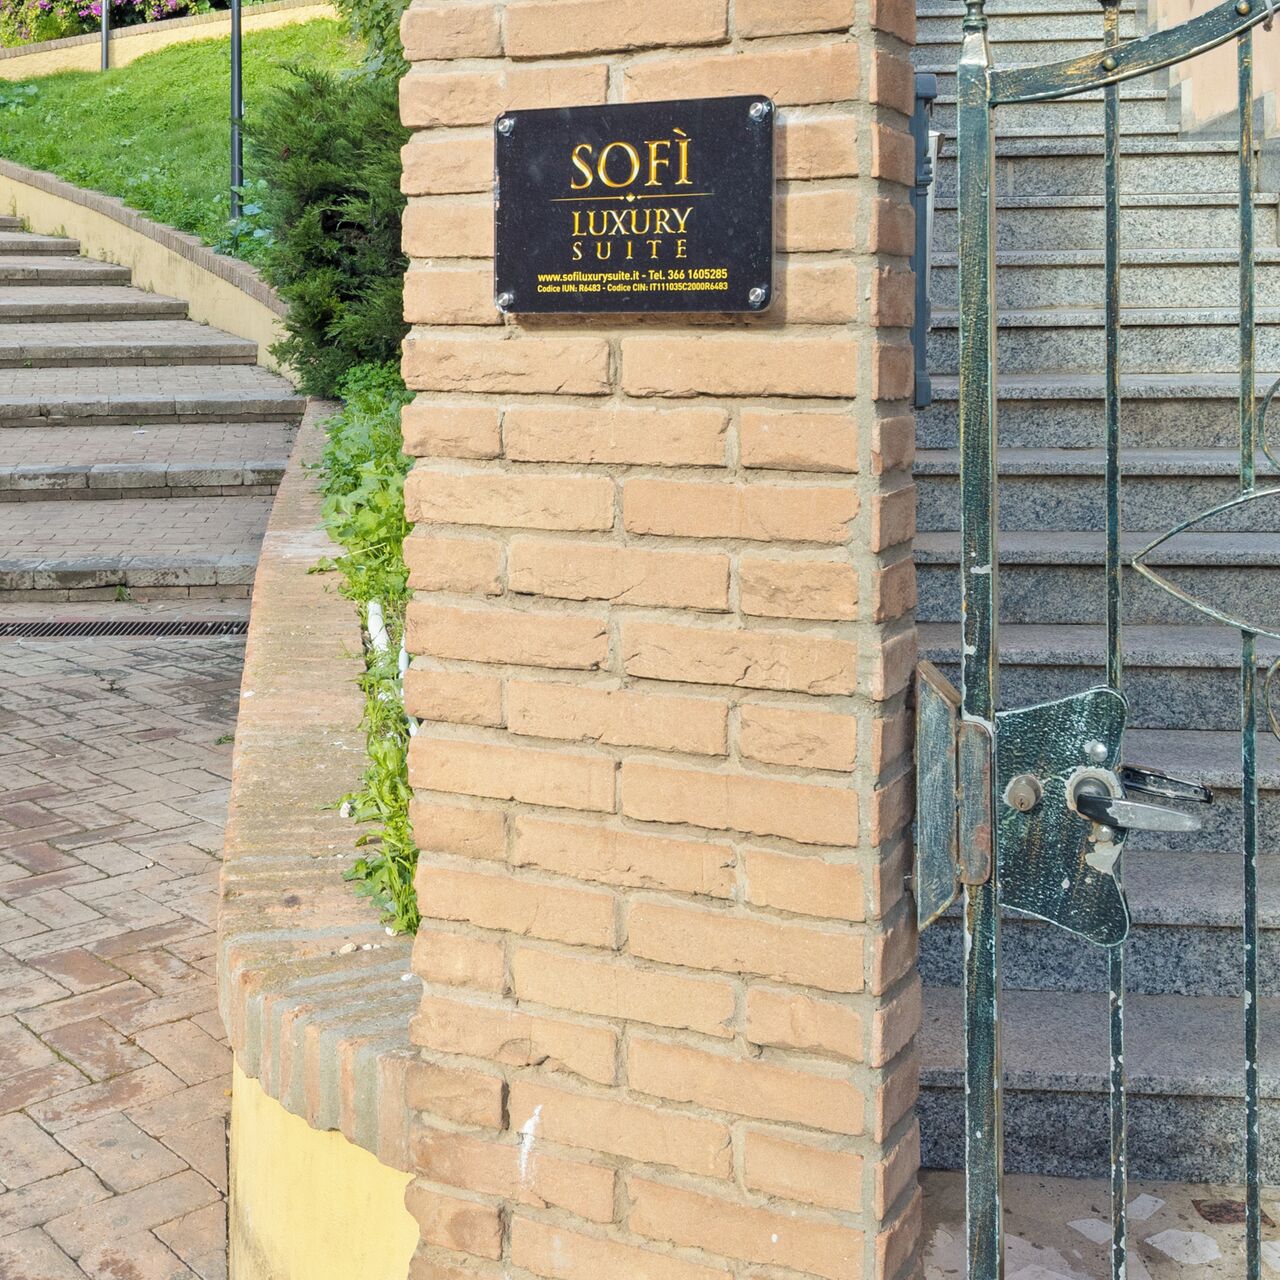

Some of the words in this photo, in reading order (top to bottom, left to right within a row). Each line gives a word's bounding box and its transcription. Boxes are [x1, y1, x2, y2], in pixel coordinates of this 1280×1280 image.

[570, 127, 694, 190] SOFÌ
[571, 207, 694, 237] LUXURY
[572, 239, 688, 261] SUITE
[537, 270, 640, 283] www.sofiluxurysuite.it
[648, 269, 666, 280] Tel.
[667, 269, 685, 280] 366
[687, 268, 728, 280] 1605285
[537, 284, 561, 293] Codice
[561, 283, 578, 293] IUN:
[579, 283, 601, 292] R6483
[607, 283, 632, 292] Codice
[632, 282, 649, 292] CIN:
[649, 281, 729, 291] IT111035C2000R6483
